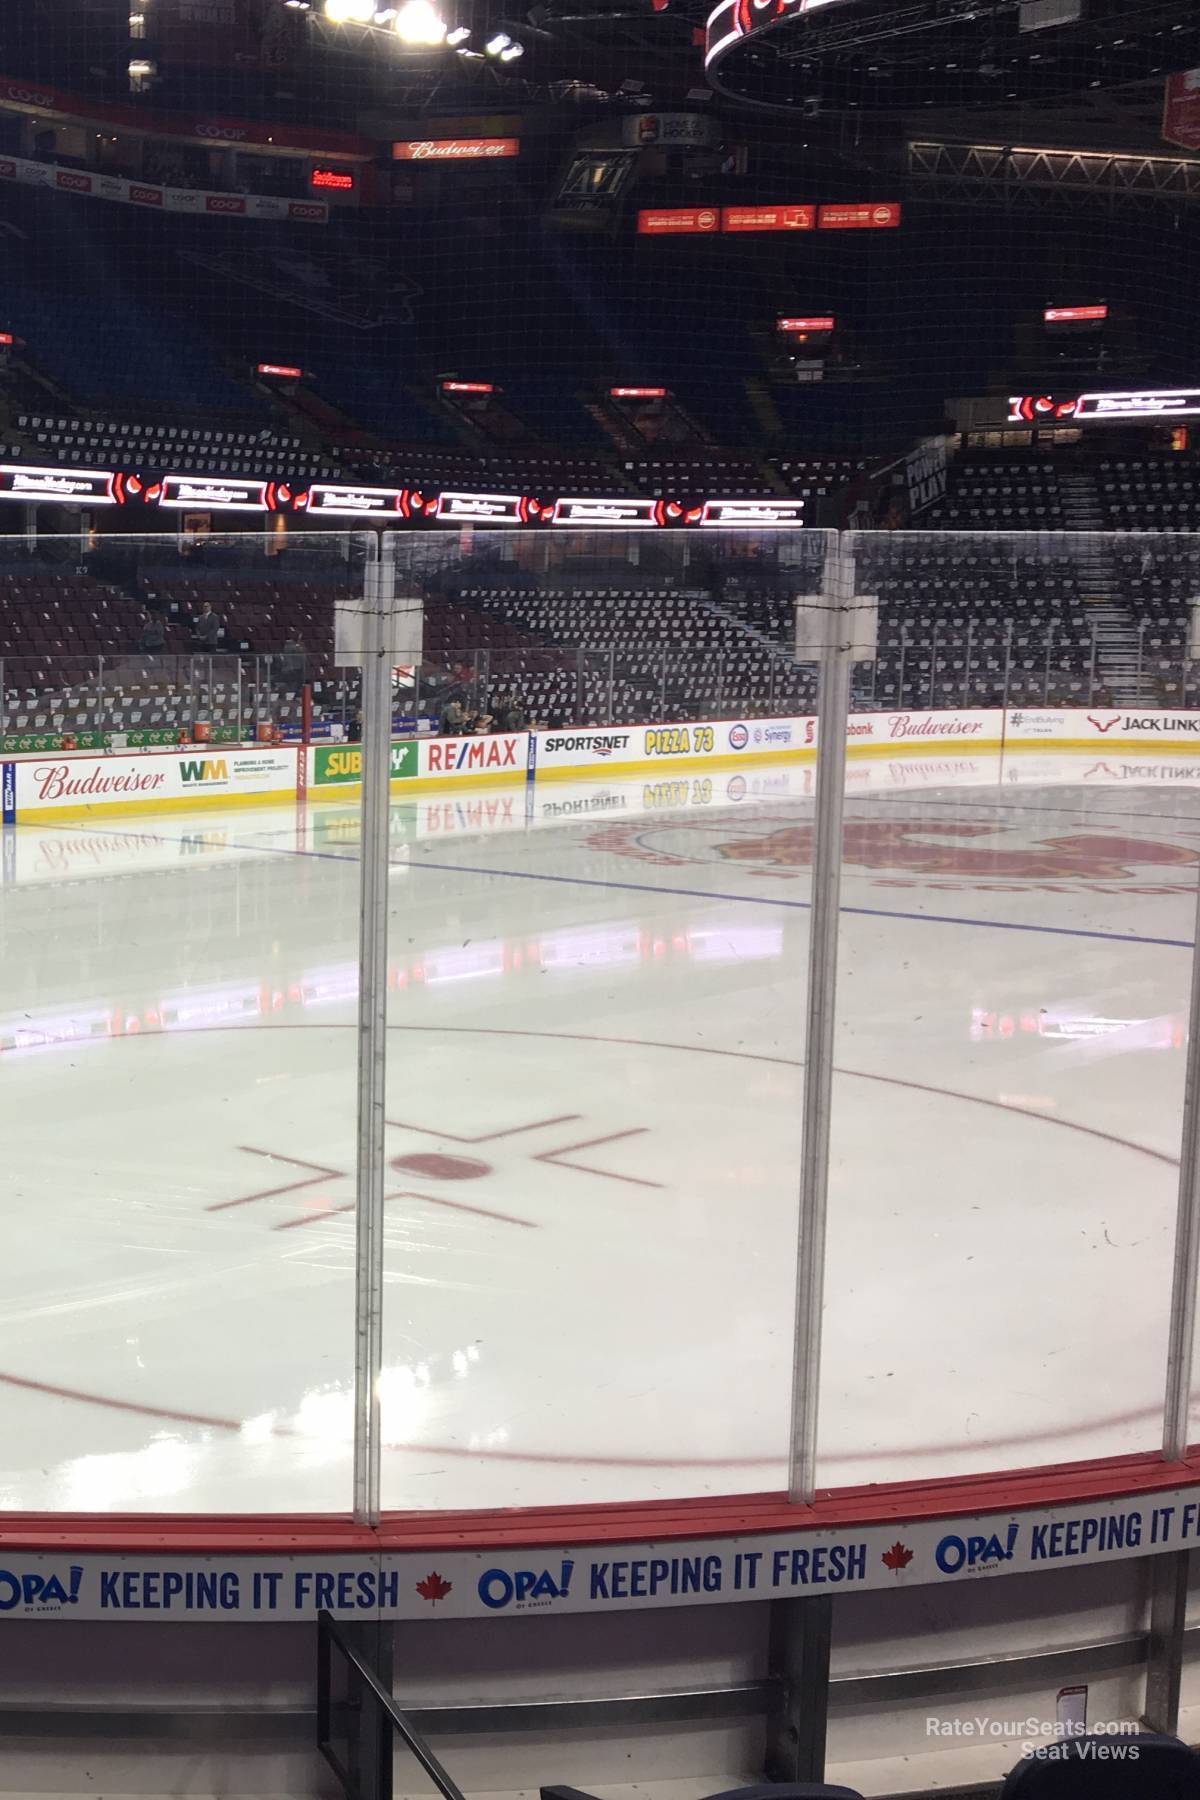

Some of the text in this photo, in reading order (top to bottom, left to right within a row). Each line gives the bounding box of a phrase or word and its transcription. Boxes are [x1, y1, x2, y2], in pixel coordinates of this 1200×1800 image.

[408, 141, 505, 159] Budweiser
[909, 468, 947, 510] PLAY
[888, 715, 984, 738] Budweiser
[1121, 716, 1162, 731] JACK
[427, 739, 517, 772] RE/MAX
[545, 735, 630, 752] SPORTSNET
[644, 726, 714, 755] PIZZA 73
[179, 759, 229, 782] WM
[325, 746, 409, 777] SUBY
[33, 765, 166, 801] Budweiser
[935, 1523, 1019, 1575] OPA!
[1030, 1510, 1143, 1561] KEEPING
[1151, 1507, 1175, 1546] IT
[101, 1570, 240, 1610] KEEPING
[251, 1571, 285, 1610] IT
[294, 1571, 398, 1610] FRESH
[477, 1543, 868, 1610] OPA! KEEPING IT FRESH
